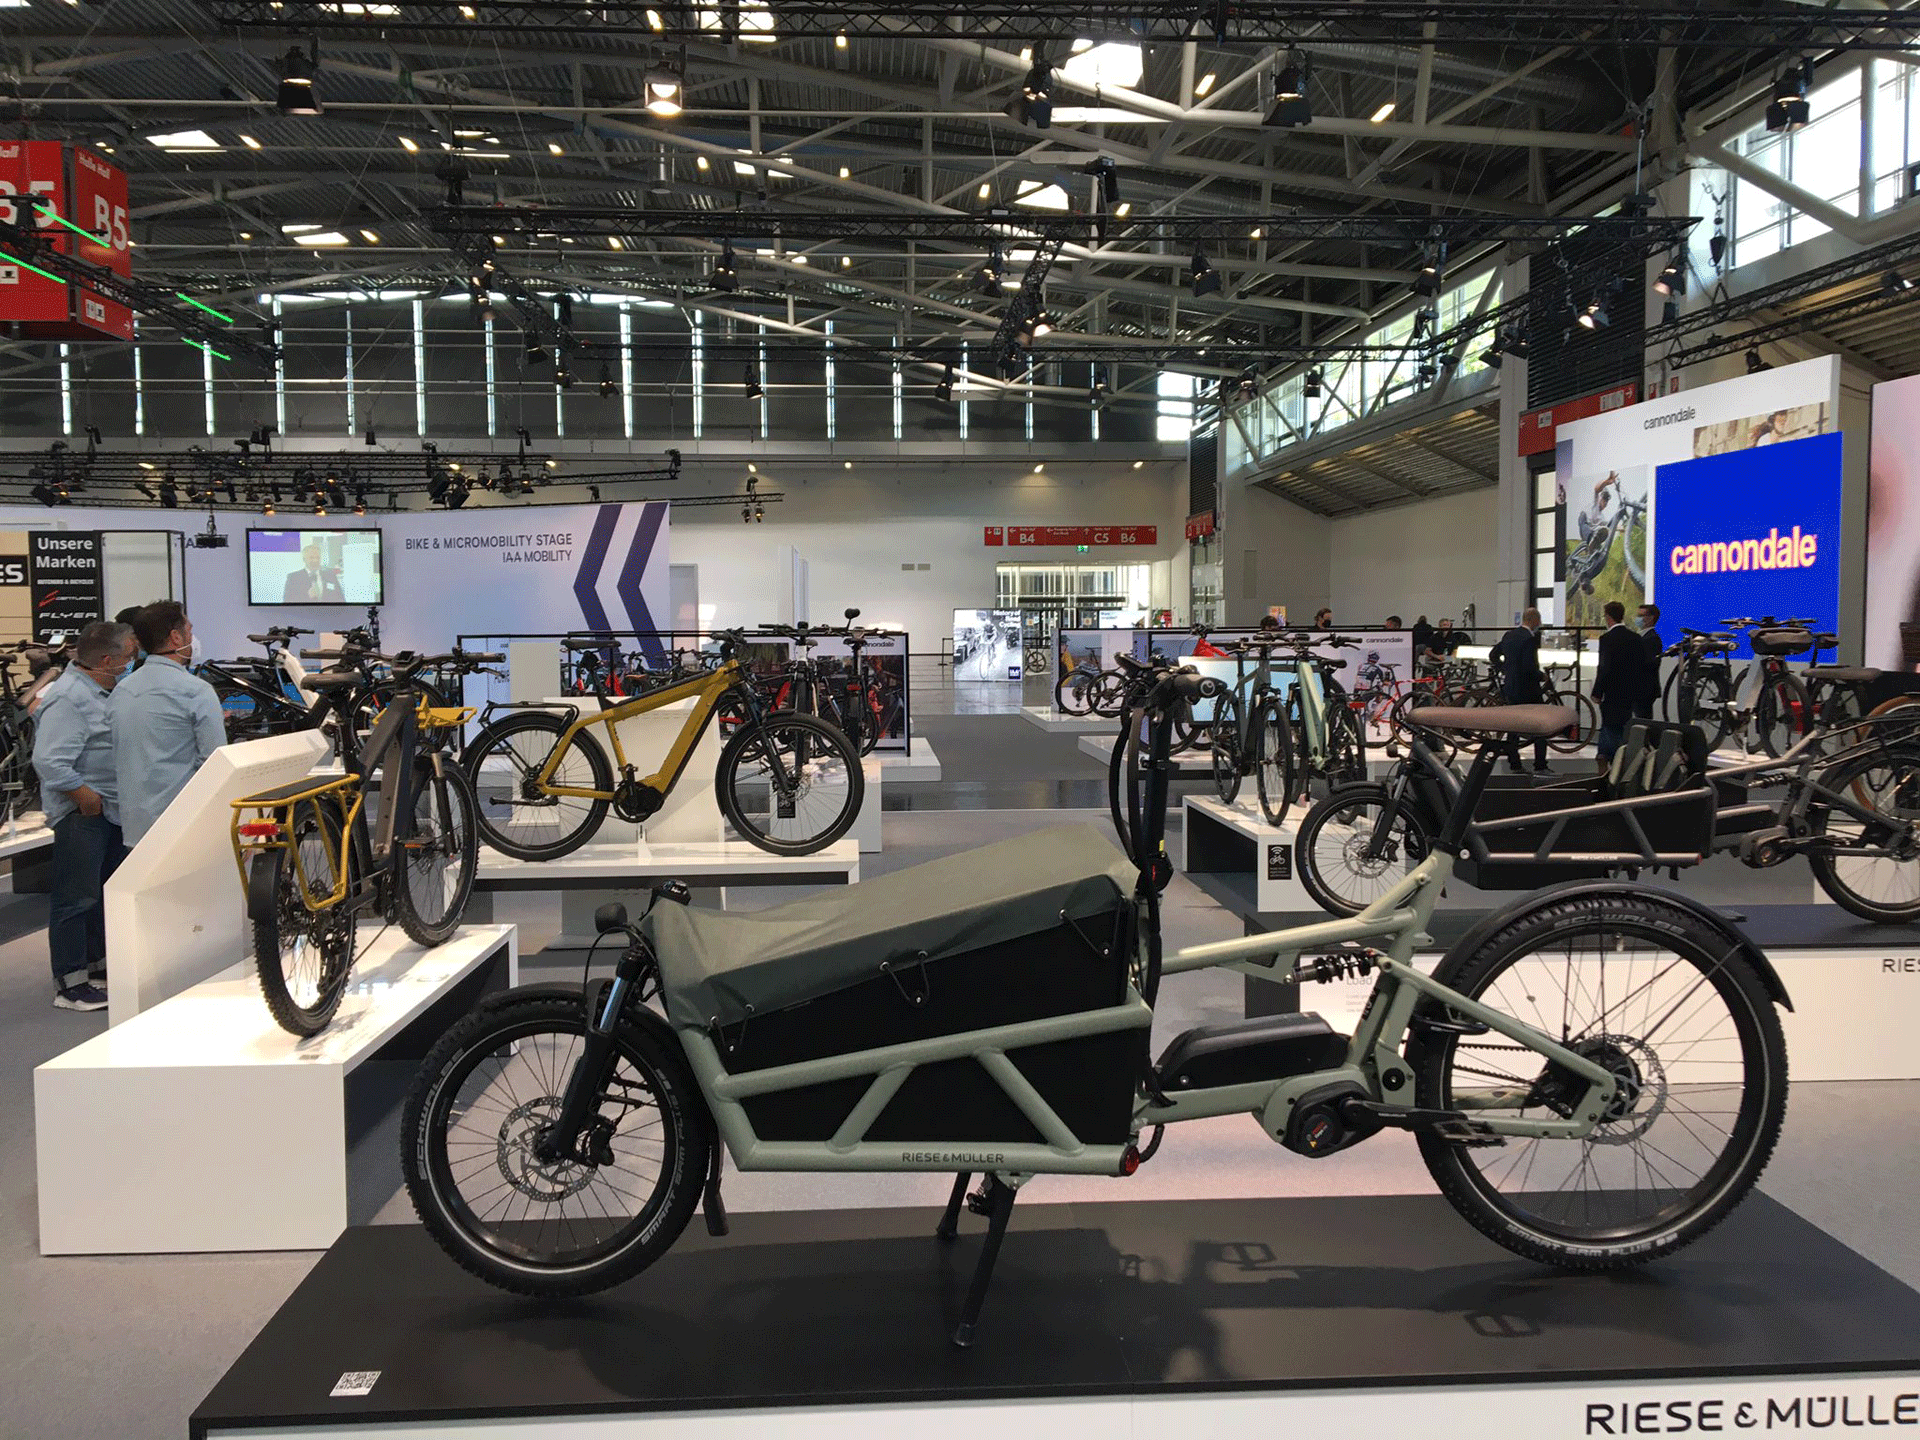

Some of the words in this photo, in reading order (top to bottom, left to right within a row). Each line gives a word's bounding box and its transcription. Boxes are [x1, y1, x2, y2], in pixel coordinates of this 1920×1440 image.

[95, 194, 128, 251] B5
[1644, 406, 1696, 430] cannondale
[37, 537, 94, 550] Unsere
[405, 538, 429, 550] BIKE
[432, 537, 440, 549] &
[443, 535, 533, 549] MICROMOBILITY
[536, 533, 573, 546] STAGE
[1020, 533, 1036, 544] B4
[1094, 533, 1109, 543] C5
[1120, 533, 1136, 543] B6
[1671, 525, 1817, 574] cannondale
[36, 555, 97, 568] Marken
[502, 551, 522, 563] IAA
[524, 550, 572, 562] MOBILITY
[0, 563, 24, 583] S
[1882, 958, 1920, 973] RIE
[1346, 975, 1373, 985] Load
[902, 1152, 941, 1162] RIESE
[951, 1152, 1004, 1163] MÜLLER
[1586, 1400, 1724, 1435] RIESE
[1734, 1402, 1759, 1428] &
[1766, 1394, 1920, 1429] MÜLLE
